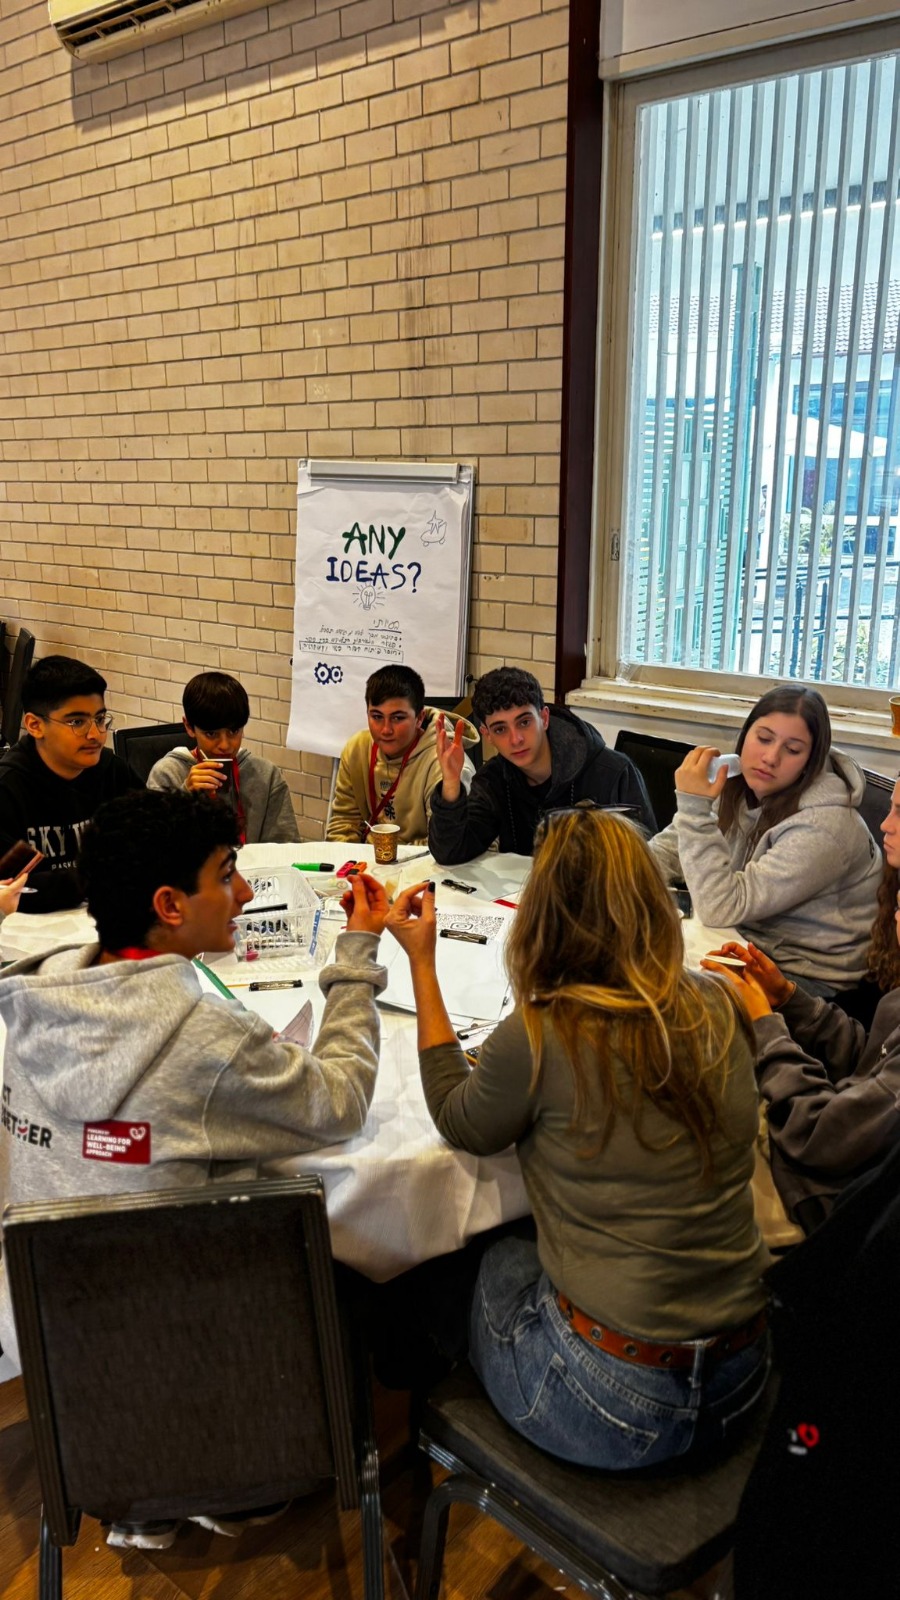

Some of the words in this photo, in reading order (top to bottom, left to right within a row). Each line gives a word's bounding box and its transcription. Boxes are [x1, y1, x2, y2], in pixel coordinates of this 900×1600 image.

[342, 522, 406, 560] ANY
[326, 557, 422, 593] IDEAS?
[27, 825, 66, 858] SKY
[86, 1141, 126, 1153] WELL-BEING
[87, 1133, 117, 1143] LEARNING
[117, 1138, 131, 1146] FOR
[86, 1149, 112, 1157] APPROACH
